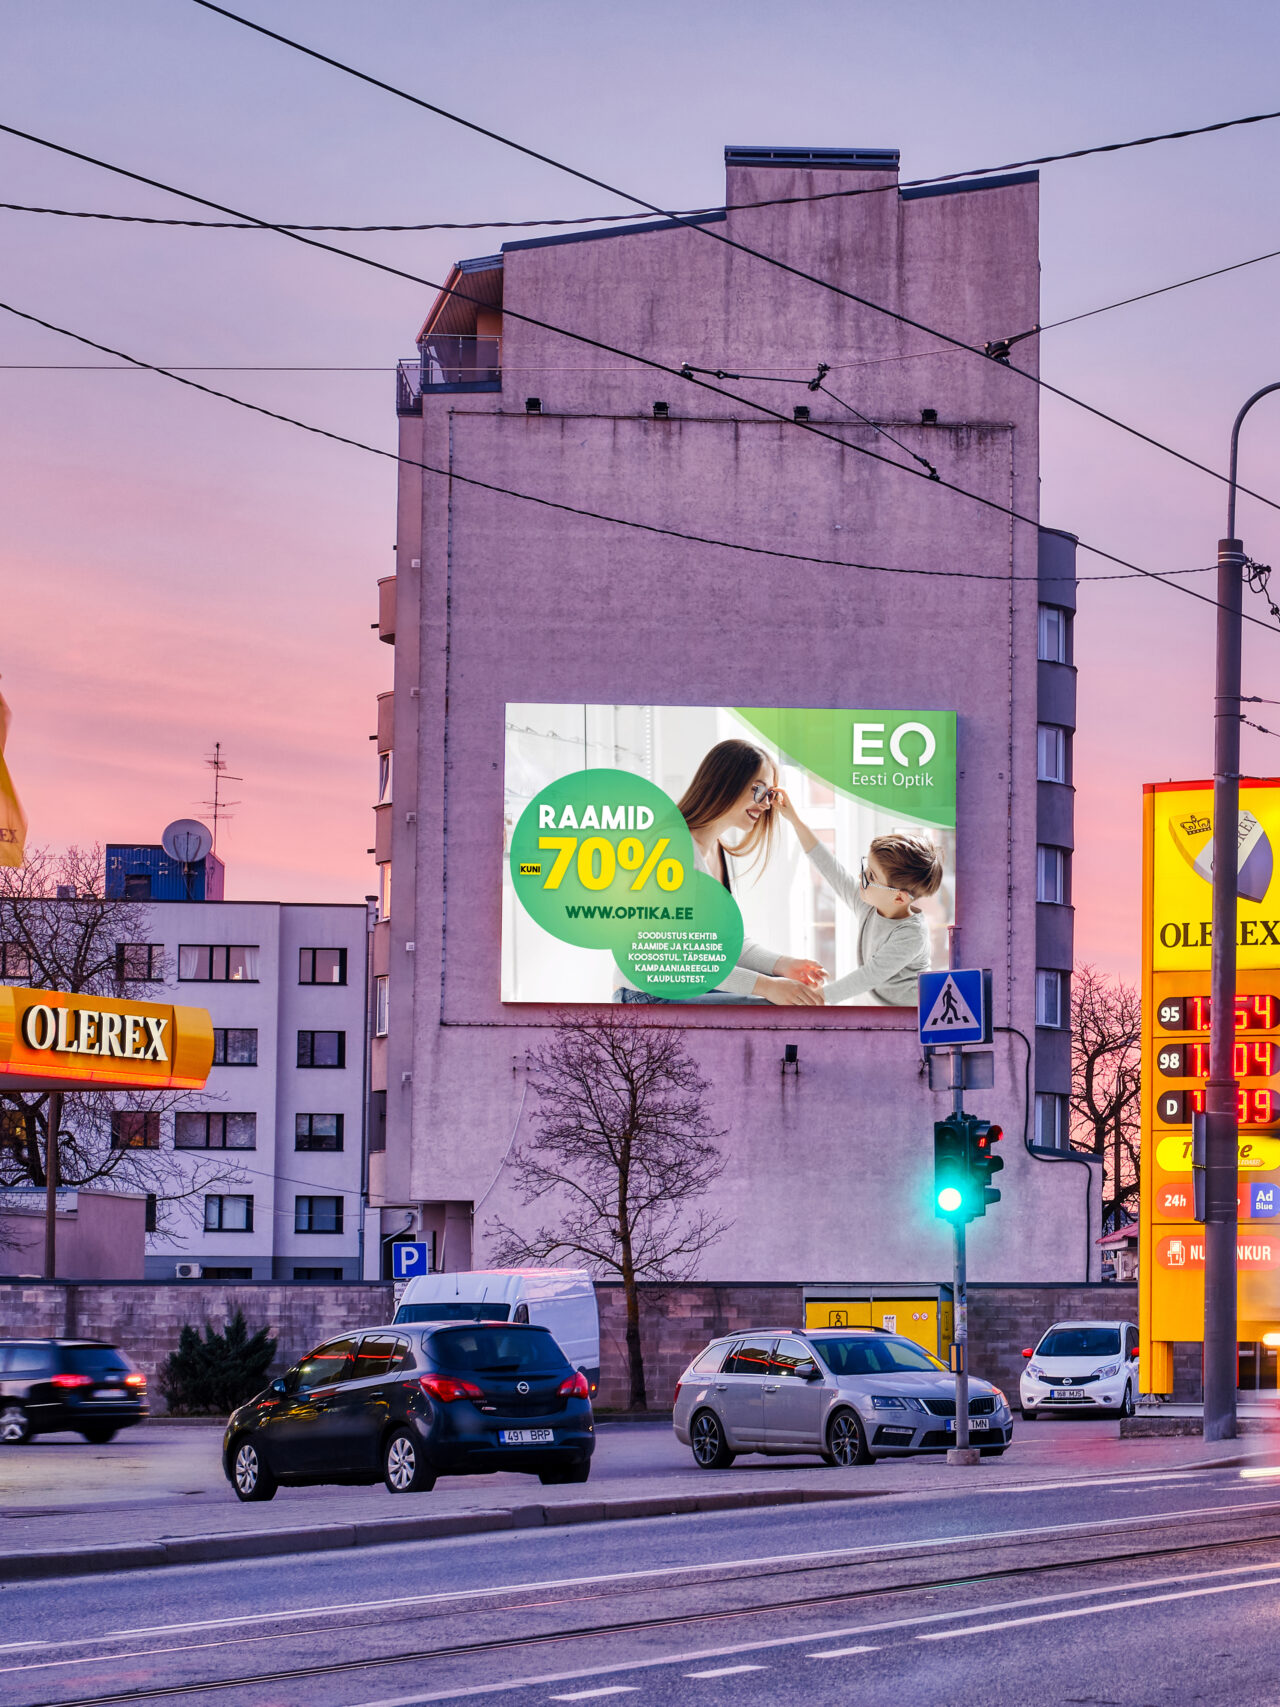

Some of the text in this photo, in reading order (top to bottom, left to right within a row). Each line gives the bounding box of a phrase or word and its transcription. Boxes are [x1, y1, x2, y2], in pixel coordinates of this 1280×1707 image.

[852, 772, 934, 789] Eesti Optik
[539, 804, 655, 830] RAAMID
[520, 865, 541, 873] KUNI
[565, 905, 694, 920] WWW.OPTIKA.EE
[637, 931, 718, 940] SOODUSTUS KEHTIB
[631, 942, 723, 951] RAAMIDE JA KLAASIDE
[628, 951, 727, 962] KOOSOSTUL. TÄPSEMAD
[634, 964, 720, 972] KAMPAANIAREEGLID
[647, 975, 707, 983] KAUPLUSTEST.
[1160, 995, 1271, 1031] 95 1.54
[23, 1004, 169, 1061] OLEREX
[1159, 1043, 1271, 1077] 98 1.04
[1166, 1089, 1271, 1123] D 139
[1164, 1194, 1187, 1207] 24h
[1256, 1190, 1273, 1202] Ad
[1255, 1202, 1273, 1210] Blue
[1190, 1244, 1271, 1261] NUNKUR
[401, 1246, 419, 1274] P
[971, 1419, 987, 1429] TMN
[507, 1430, 551, 1442] 491 BRP
